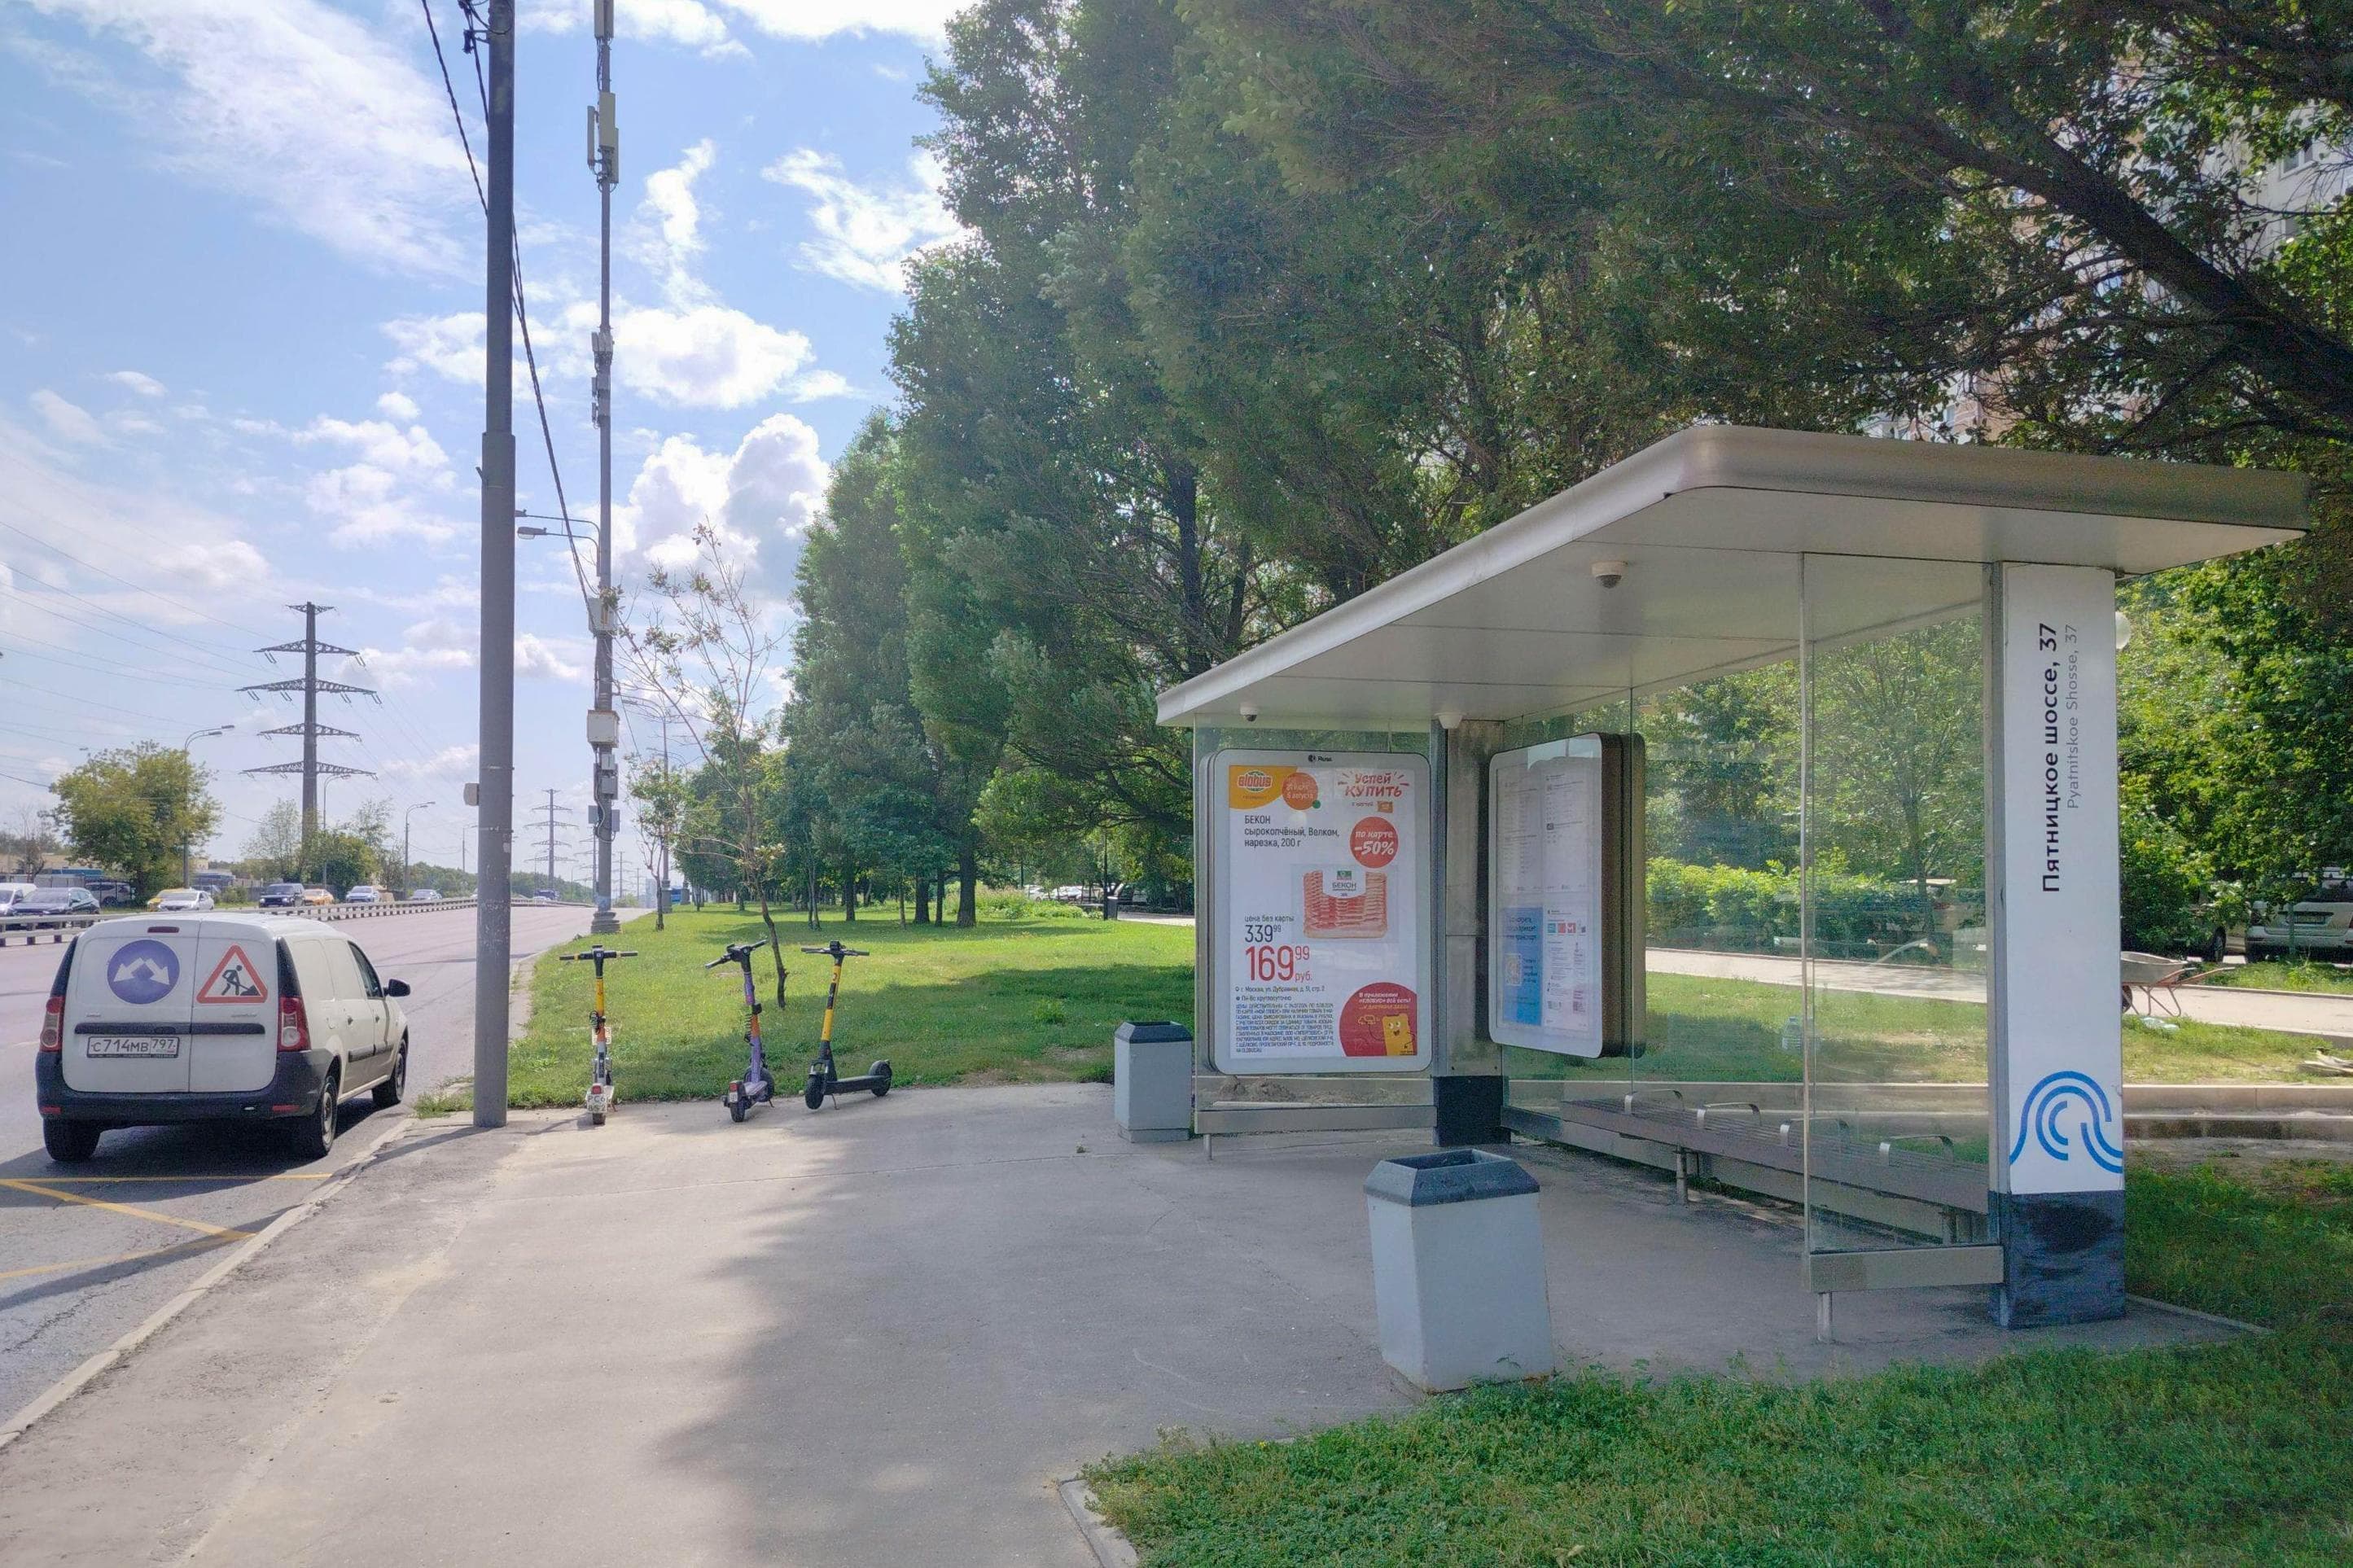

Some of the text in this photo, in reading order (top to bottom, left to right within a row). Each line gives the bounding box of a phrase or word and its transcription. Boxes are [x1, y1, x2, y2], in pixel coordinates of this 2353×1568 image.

[2065, 624, 2082, 809] Pyatnitskoe Shosse, 37
[2039, 623, 2061, 892] Пятницкое шоссе, 37
[1355, 772, 1392, 784] Успей
[1345, 786, 1403, 798] КУПИТЬ
[1244, 815, 1271, 825] БЕКОН
[1244, 826, 1340, 838] сырокопчёный, Велком,
[1368, 831, 1393, 840] карте
[1244, 839, 1280, 848] нарезка,
[1281, 838, 1296, 848] 200
[1261, 914, 1273, 922] без
[1244, 924, 1282, 943] 339 99
[1245, 945, 1313, 983] 169 99 руб.
[151, 1038, 174, 1050] 797
